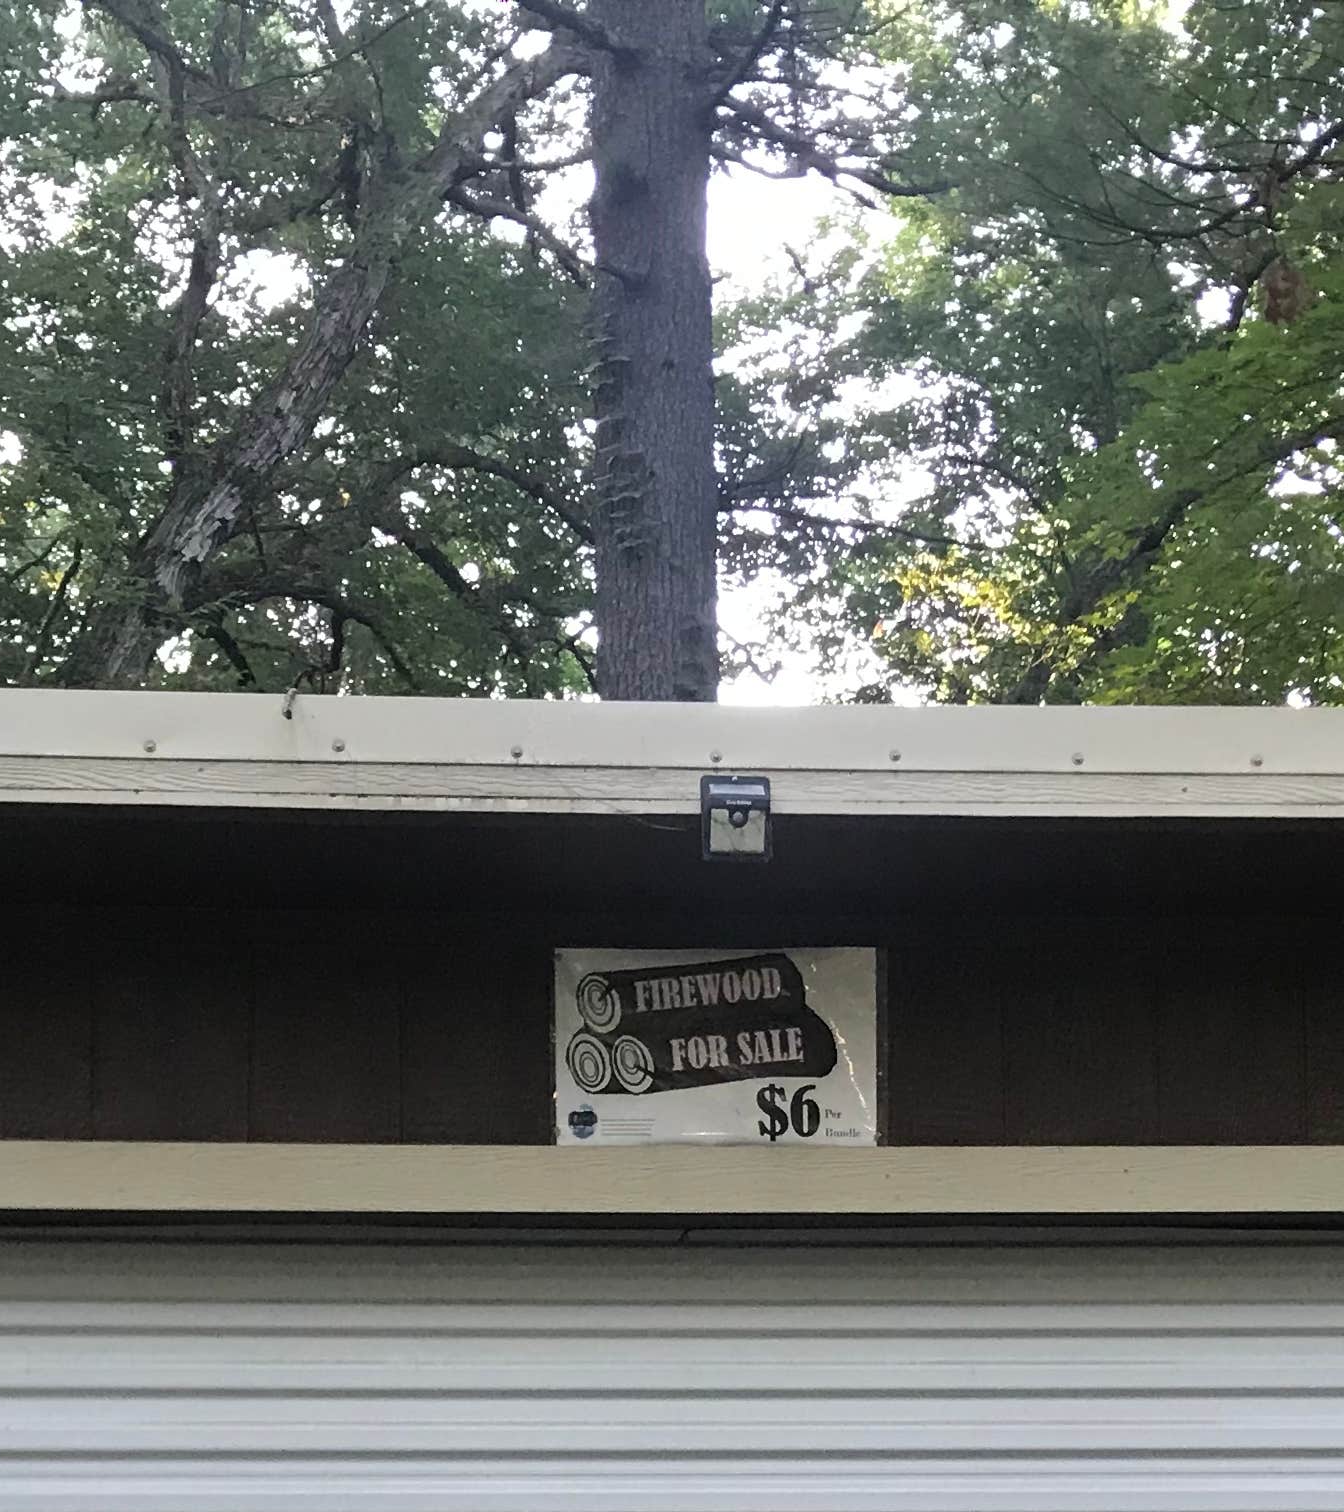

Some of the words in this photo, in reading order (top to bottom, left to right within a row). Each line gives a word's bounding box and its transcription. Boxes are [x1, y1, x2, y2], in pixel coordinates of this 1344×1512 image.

[633, 967, 782, 1013] FIREWOOD
[669, 1036, 730, 1072] FOR
[737, 1027, 804, 1065] SALE
[757, 1083, 820, 1141] $6
[825, 1109, 841, 1119] Per
